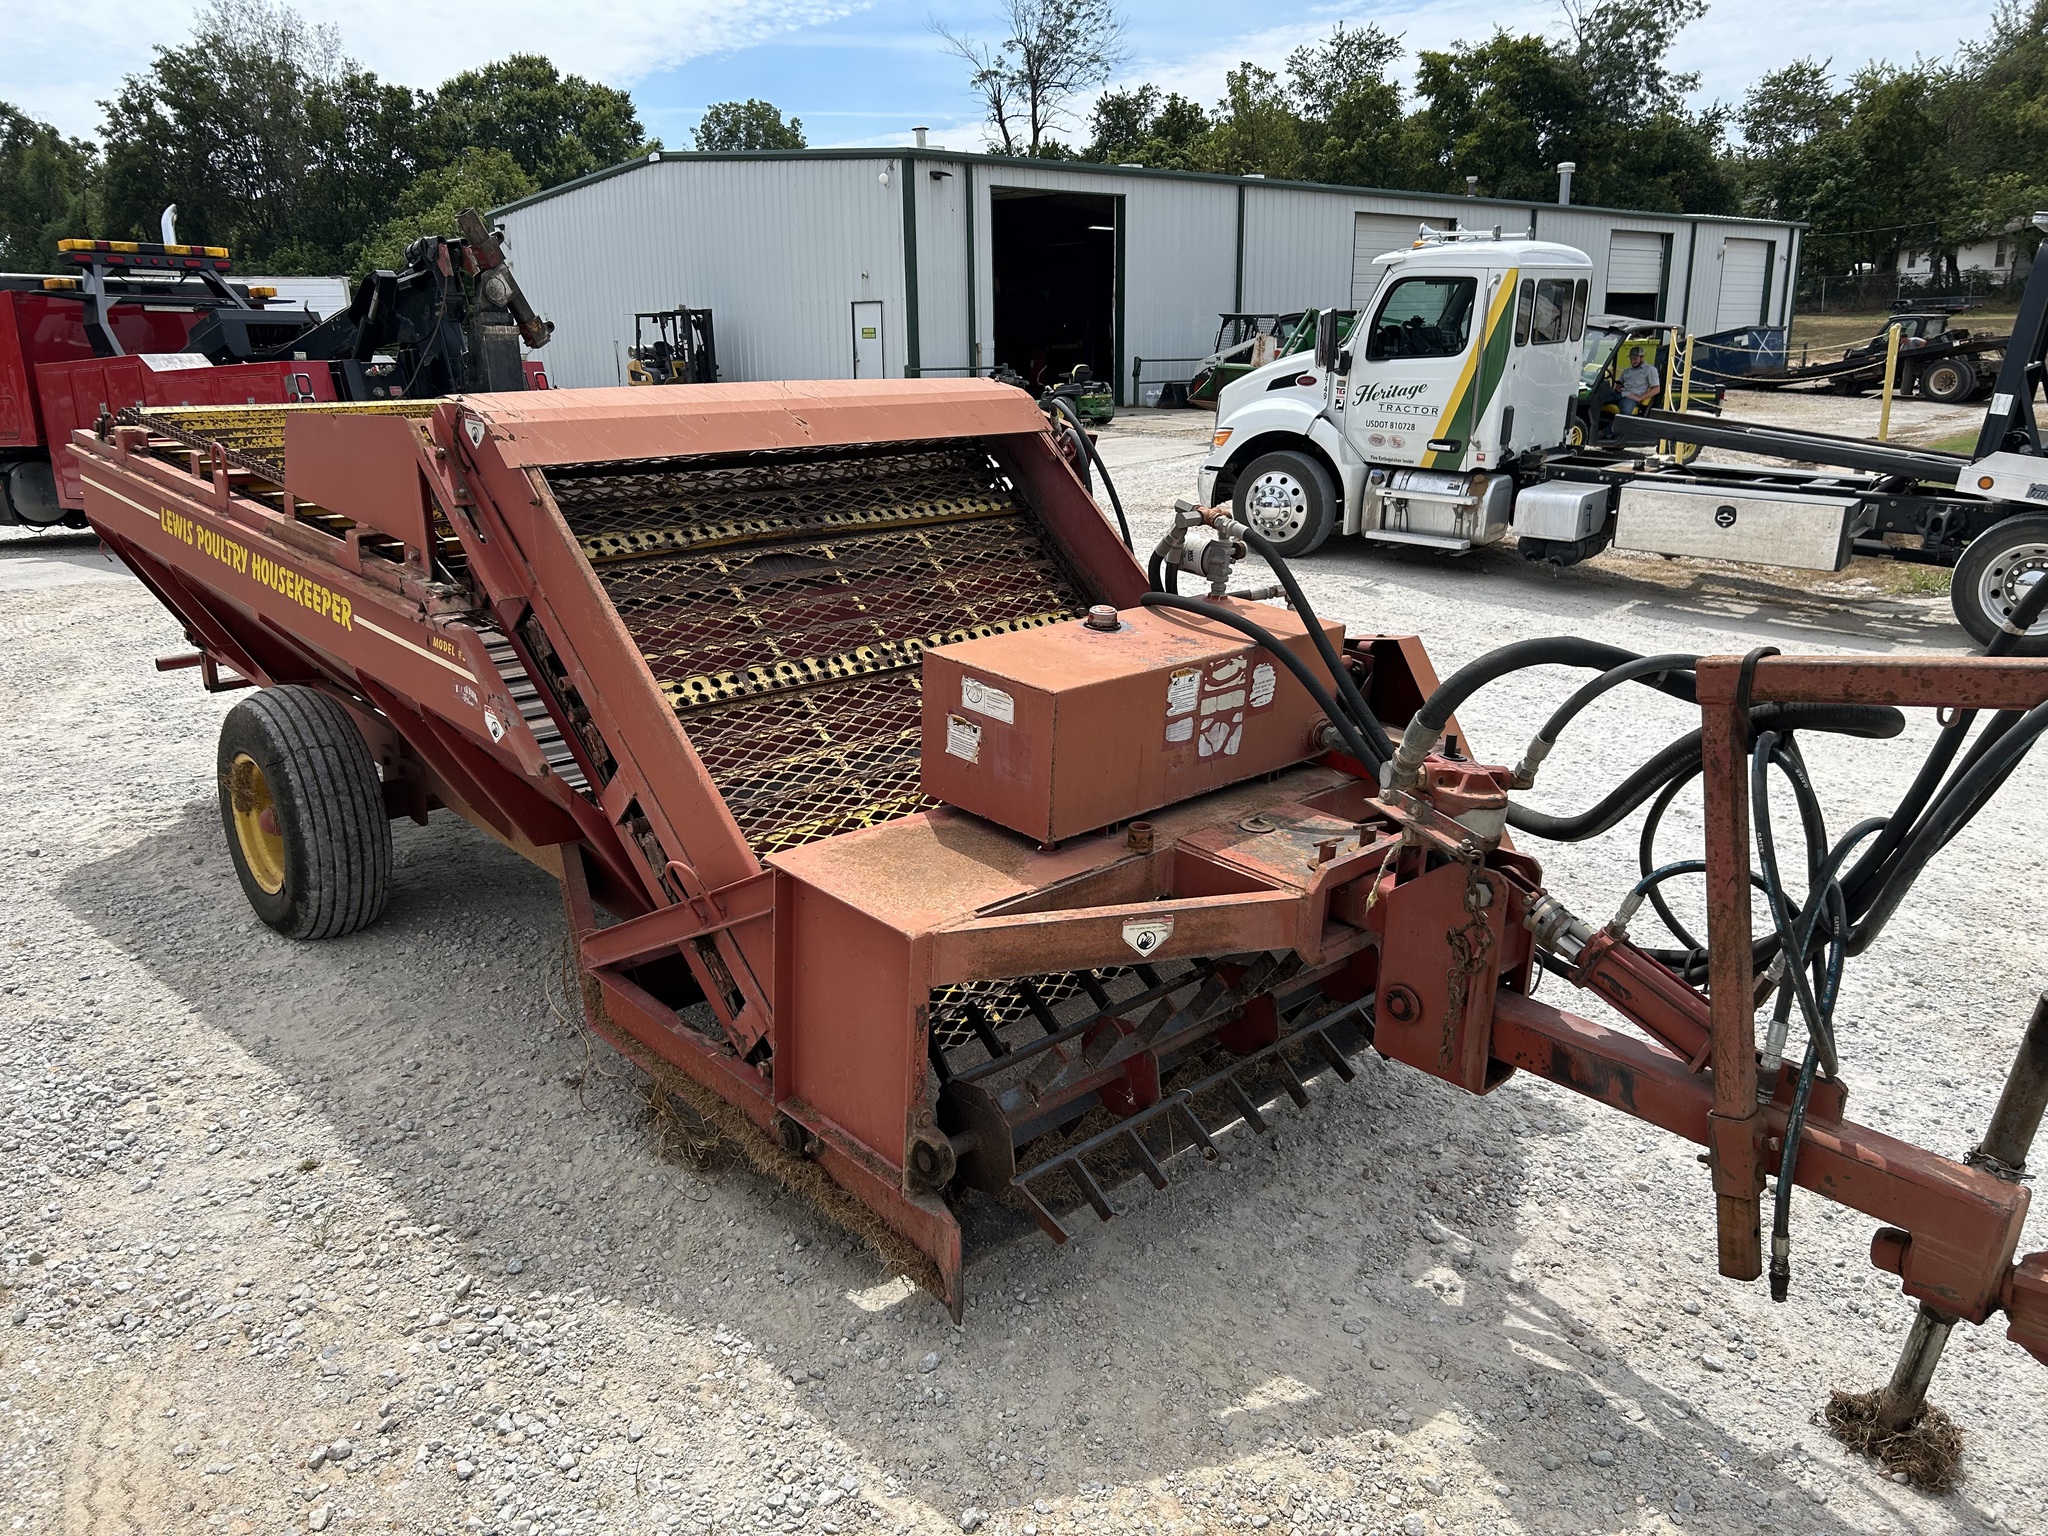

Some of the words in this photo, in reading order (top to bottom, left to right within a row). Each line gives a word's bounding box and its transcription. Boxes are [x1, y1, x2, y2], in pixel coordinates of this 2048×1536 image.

[1353, 382, 1428, 406] Heritage
[1378, 403, 1439, 416] TRACTOR
[1365, 419, 1389, 429] USDOT
[1389, 421, 1416, 431] 810728
[160, 506, 194, 546] LEWIS
[196, 525, 248, 574] POULTRY
[252, 552, 352, 632] HOUSEKEEPER
[432, 636, 456, 657] MODEL
[1756, 832, 1764, 855] GATES
